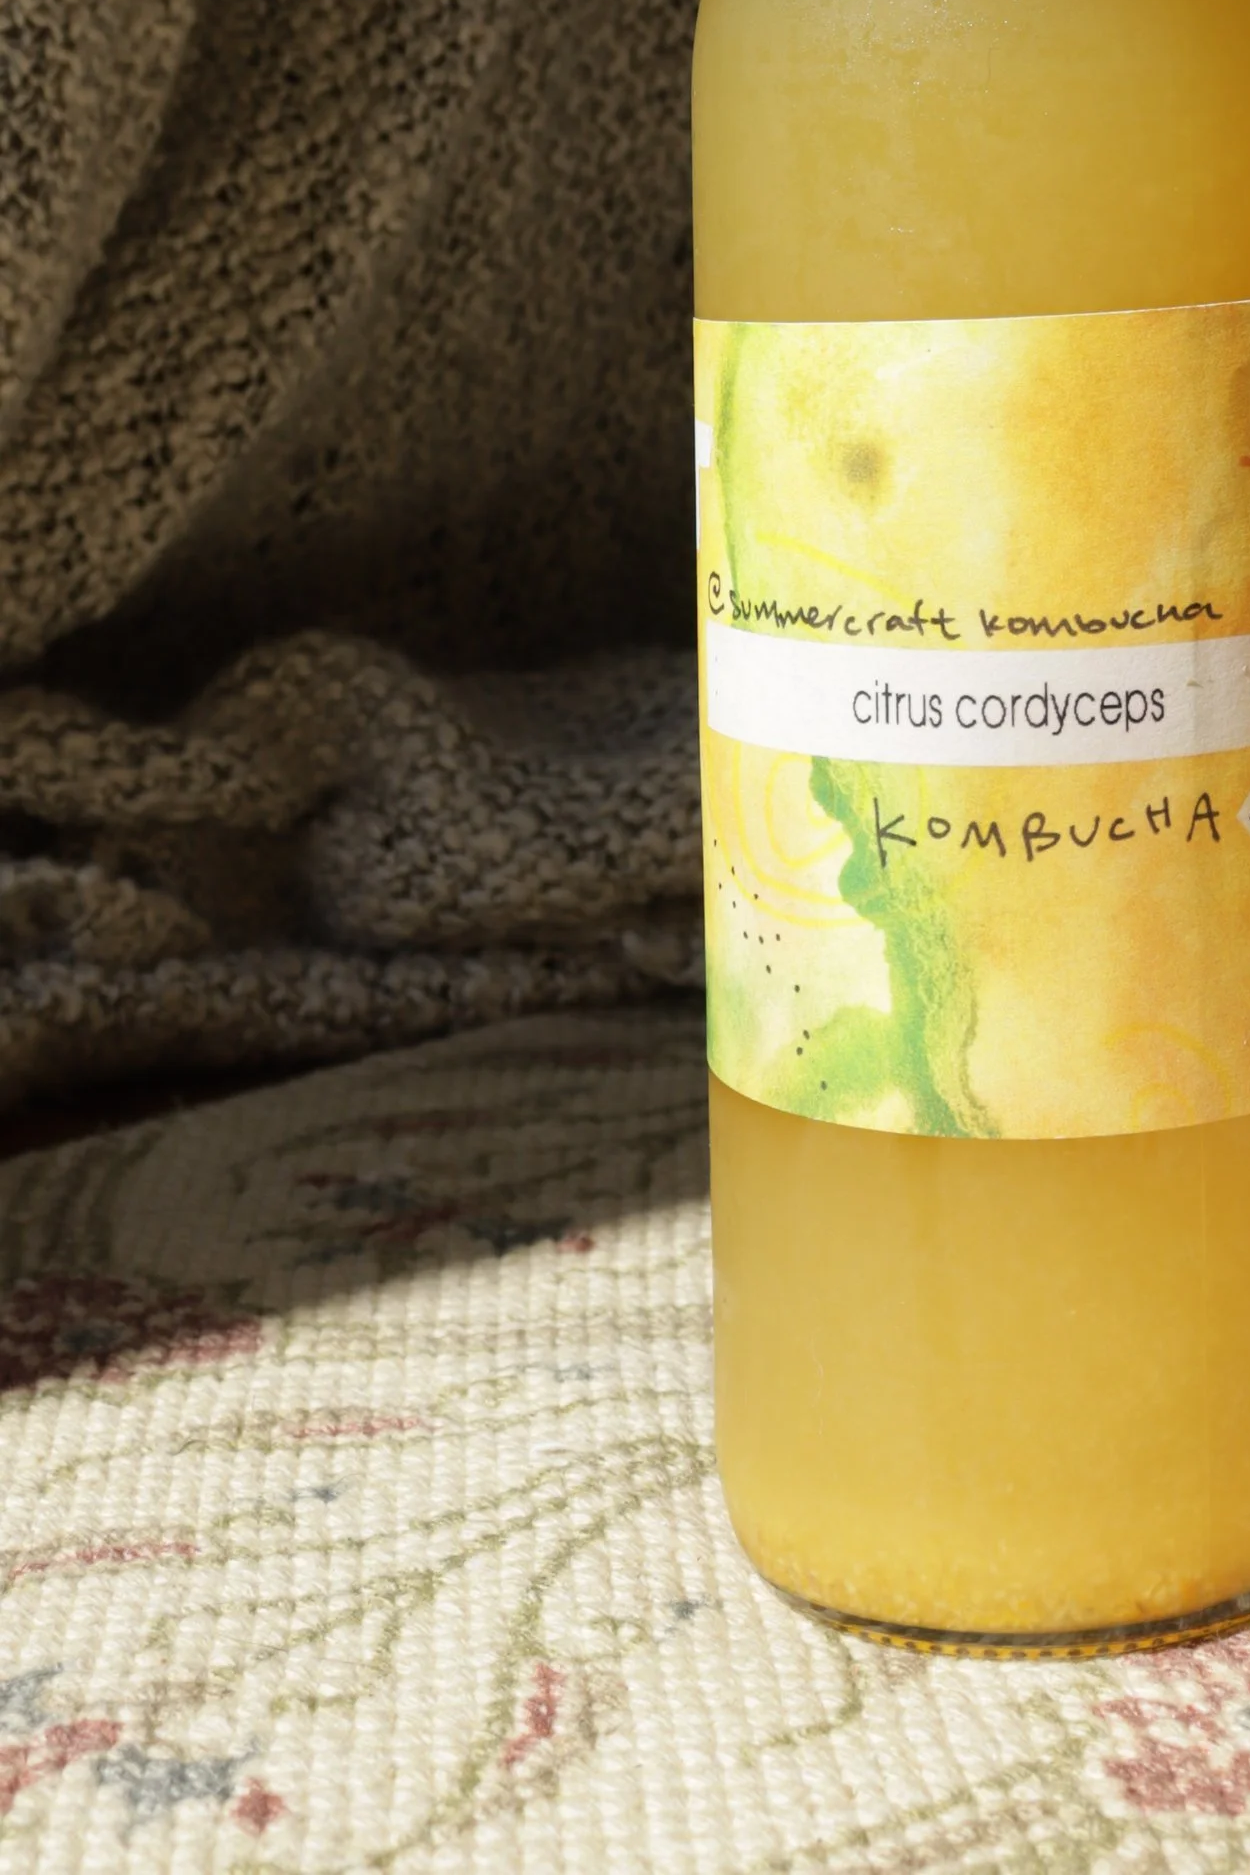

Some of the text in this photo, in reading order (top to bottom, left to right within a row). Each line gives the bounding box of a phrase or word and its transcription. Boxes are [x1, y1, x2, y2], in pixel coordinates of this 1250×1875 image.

[852, 679, 1165, 736] citrus cordyceps
[873, 793, 1221, 869] KOMBUCHA
